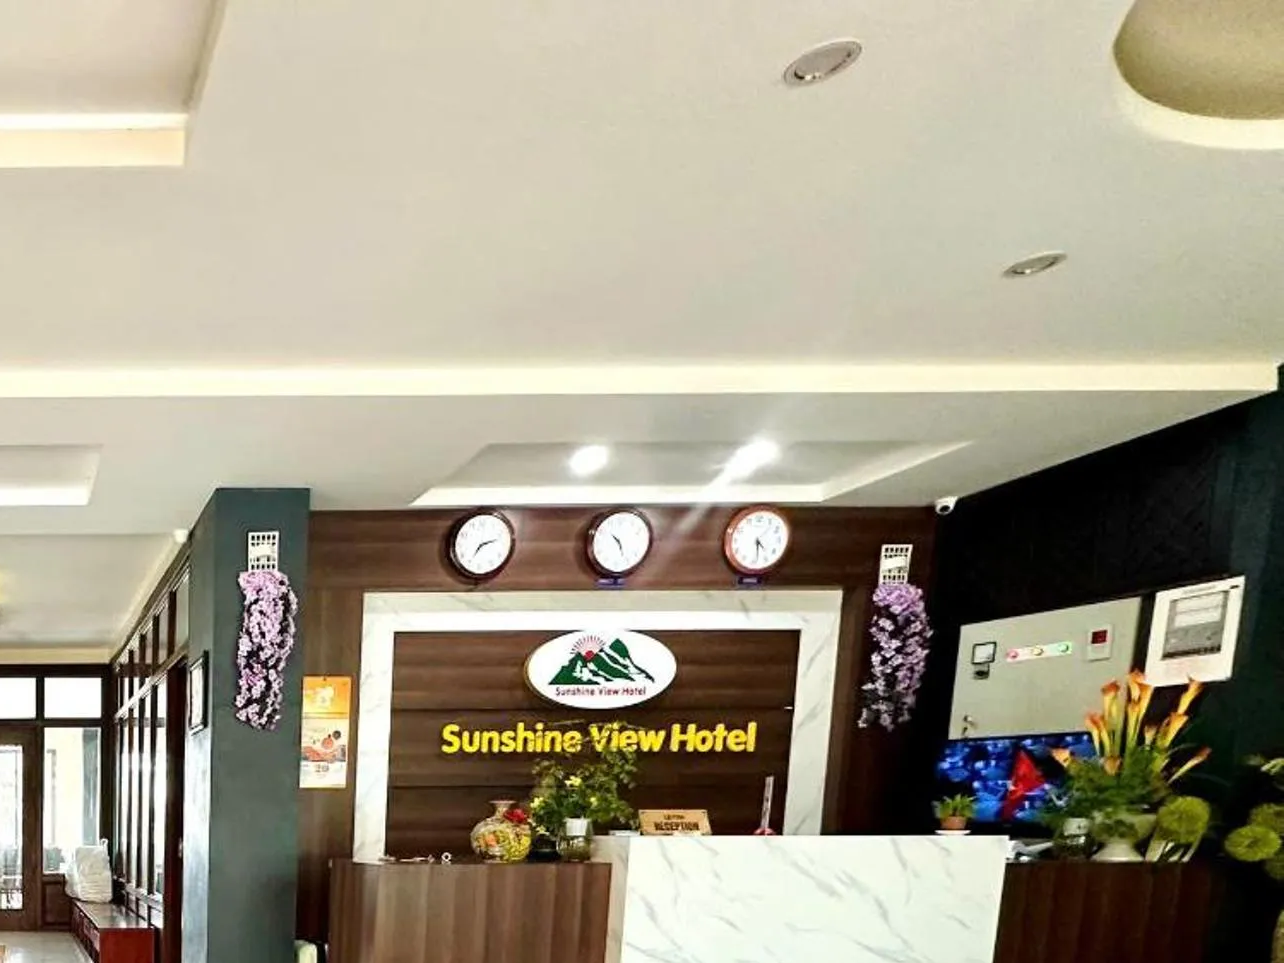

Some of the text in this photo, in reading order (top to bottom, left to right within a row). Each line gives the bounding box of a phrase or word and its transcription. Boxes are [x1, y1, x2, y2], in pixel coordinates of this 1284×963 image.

[555, 685, 646, 697] Sunshine View Hotel
[441, 722, 758, 753] Sunshine View Hotel
